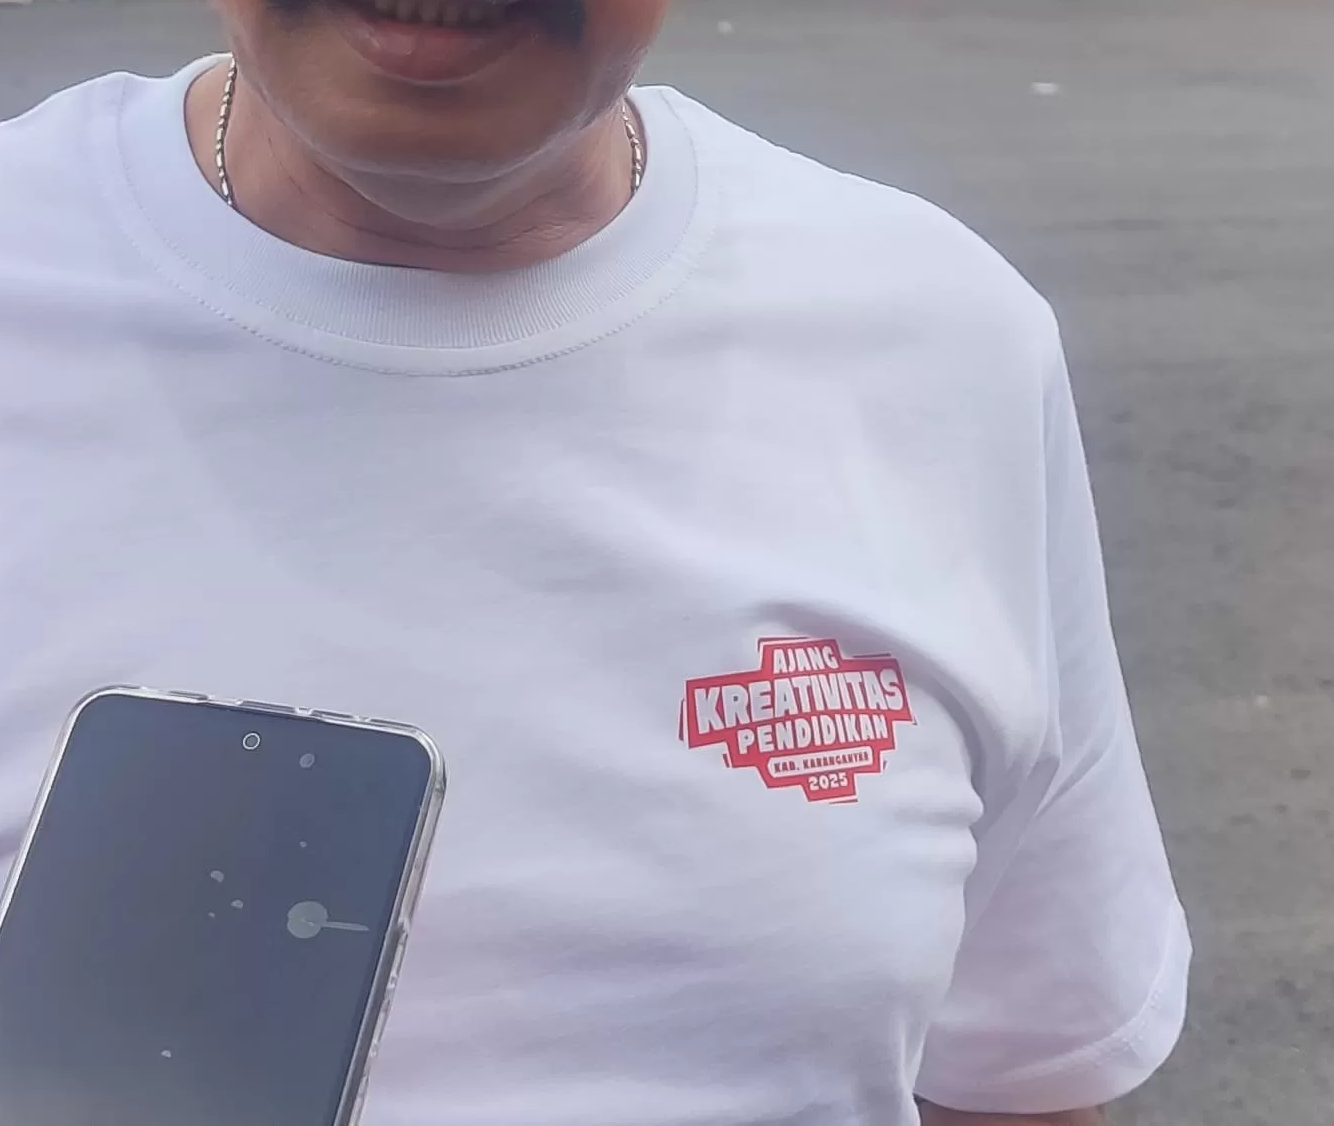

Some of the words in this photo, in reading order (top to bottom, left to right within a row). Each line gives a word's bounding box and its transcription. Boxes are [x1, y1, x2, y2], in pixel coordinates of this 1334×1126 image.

[773, 645, 839, 674] AJANG
[693, 669, 904, 735] KREATIVITAS
[737, 713, 889, 755] PENDIDIKAN
[774, 760, 800, 774] KAB.
[808, 772, 849, 791] 2025
